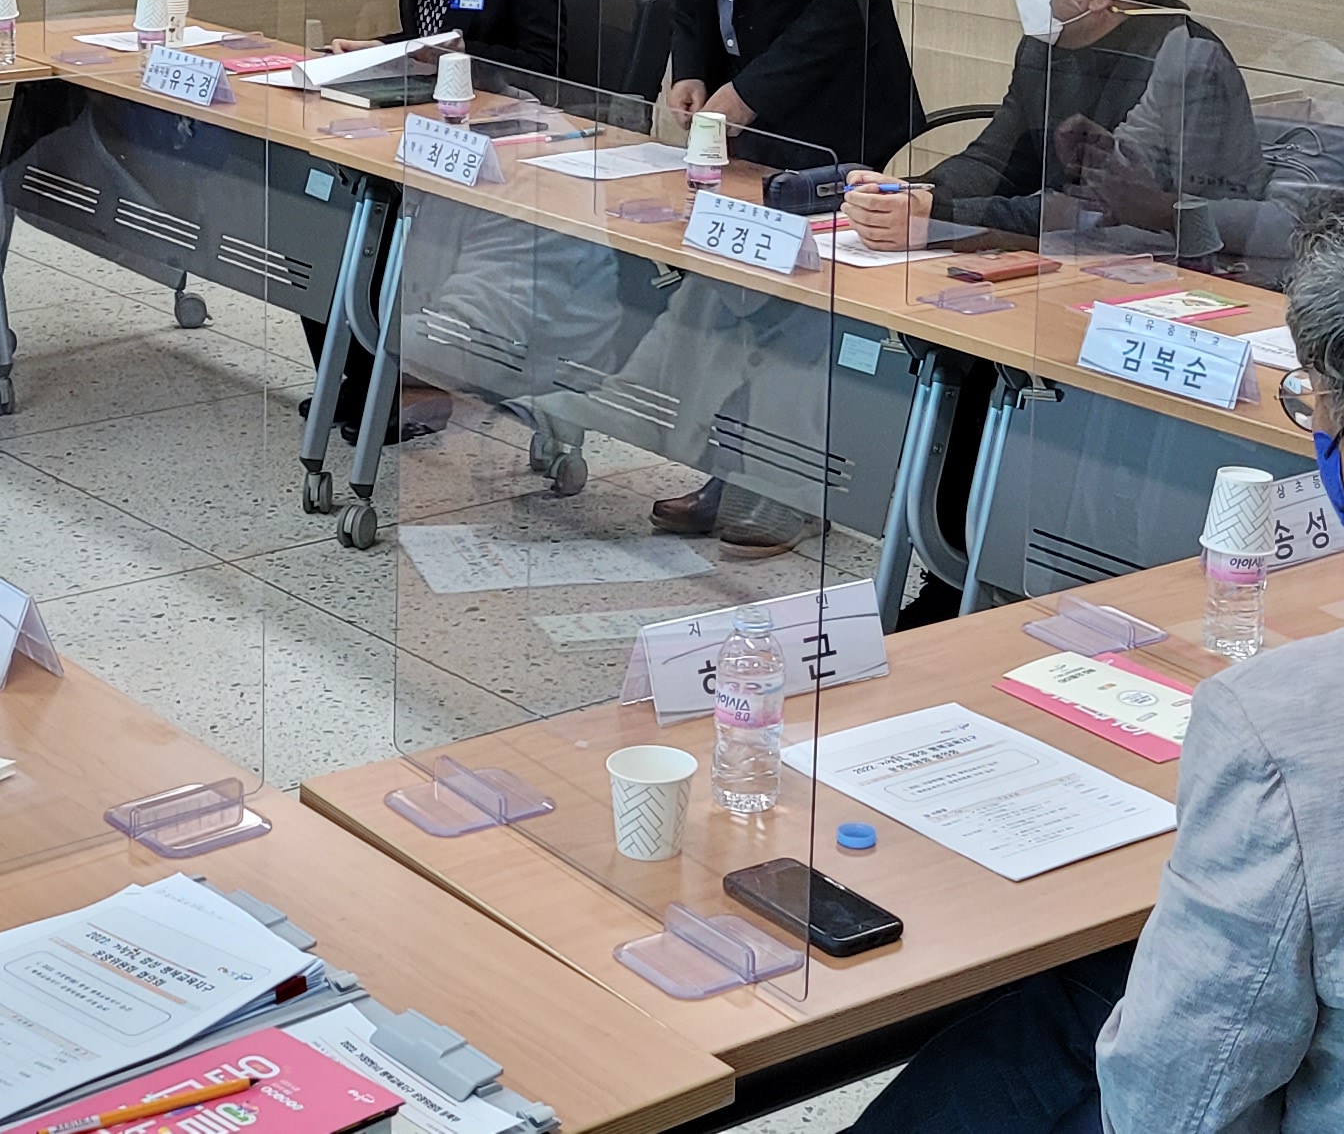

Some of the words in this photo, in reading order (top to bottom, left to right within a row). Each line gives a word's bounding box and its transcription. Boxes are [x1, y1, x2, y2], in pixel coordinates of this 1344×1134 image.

[169, 69, 212, 98] 유수경
[706, 220, 772, 262] 강경근
[1124, 313, 1220, 346] 덕유중학교
[1122, 338, 1208, 390] 김복순
[1274, 507, 1330, 561] 송성
[734, 711, 751, 722] 8.0
